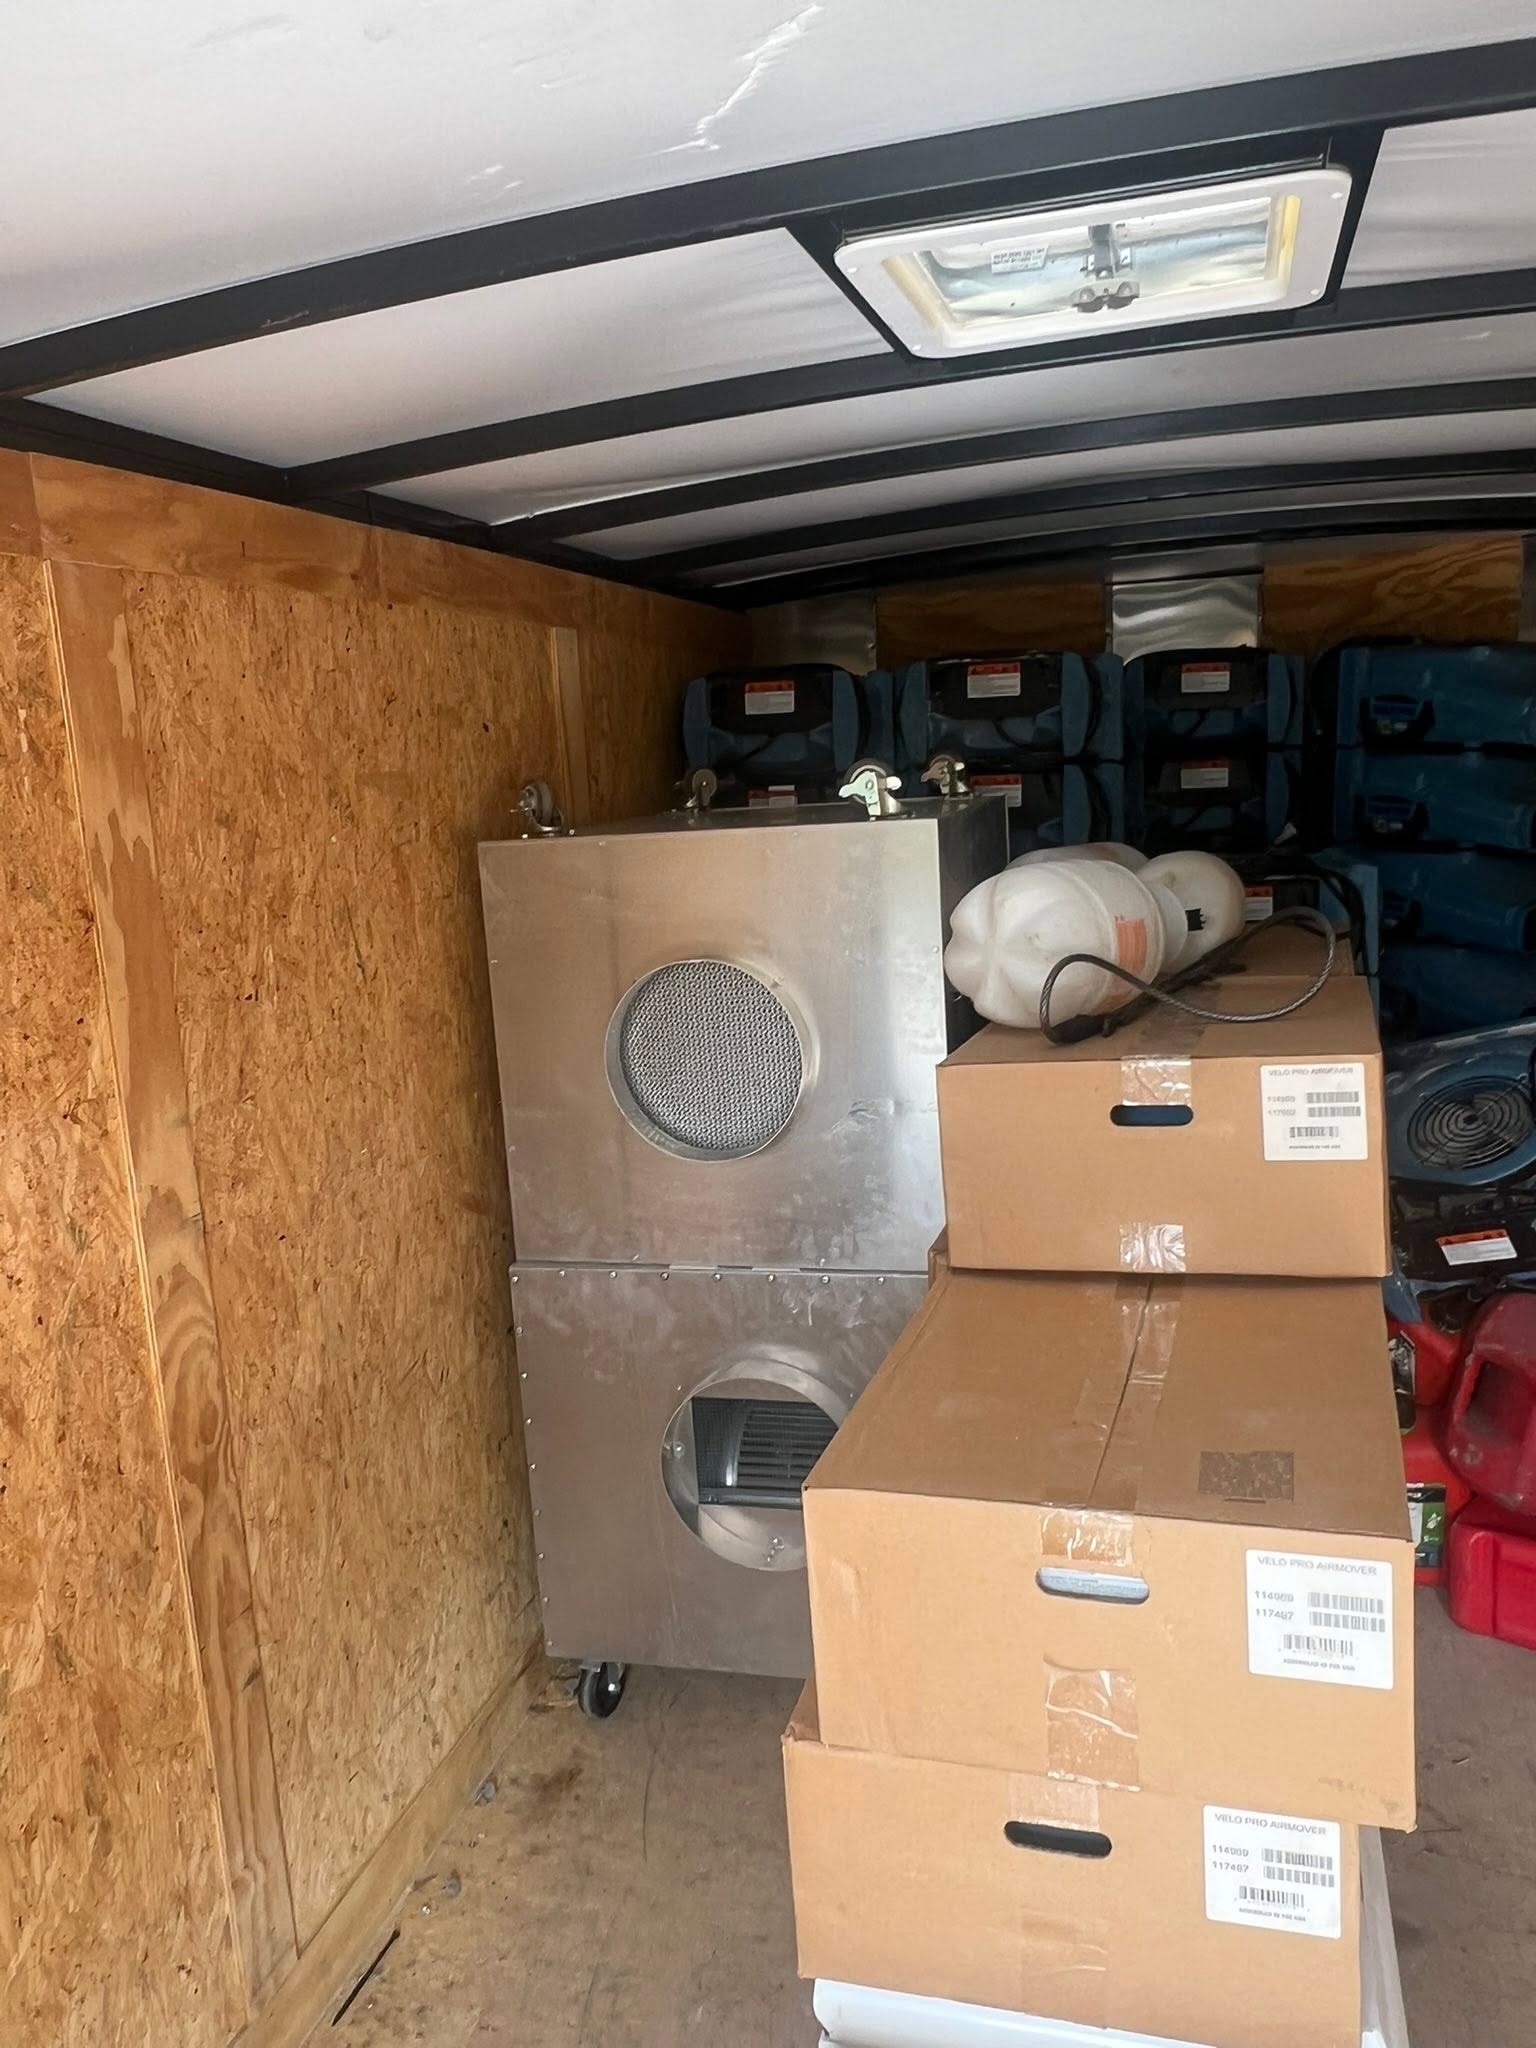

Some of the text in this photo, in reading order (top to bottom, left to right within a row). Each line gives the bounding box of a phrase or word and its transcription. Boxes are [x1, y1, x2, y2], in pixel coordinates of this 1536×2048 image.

[1257, 1556, 1377, 1575] VELO PRO AIRMOVER
[1214, 1813, 1327, 1836] VELO PRO AIRMOVER
